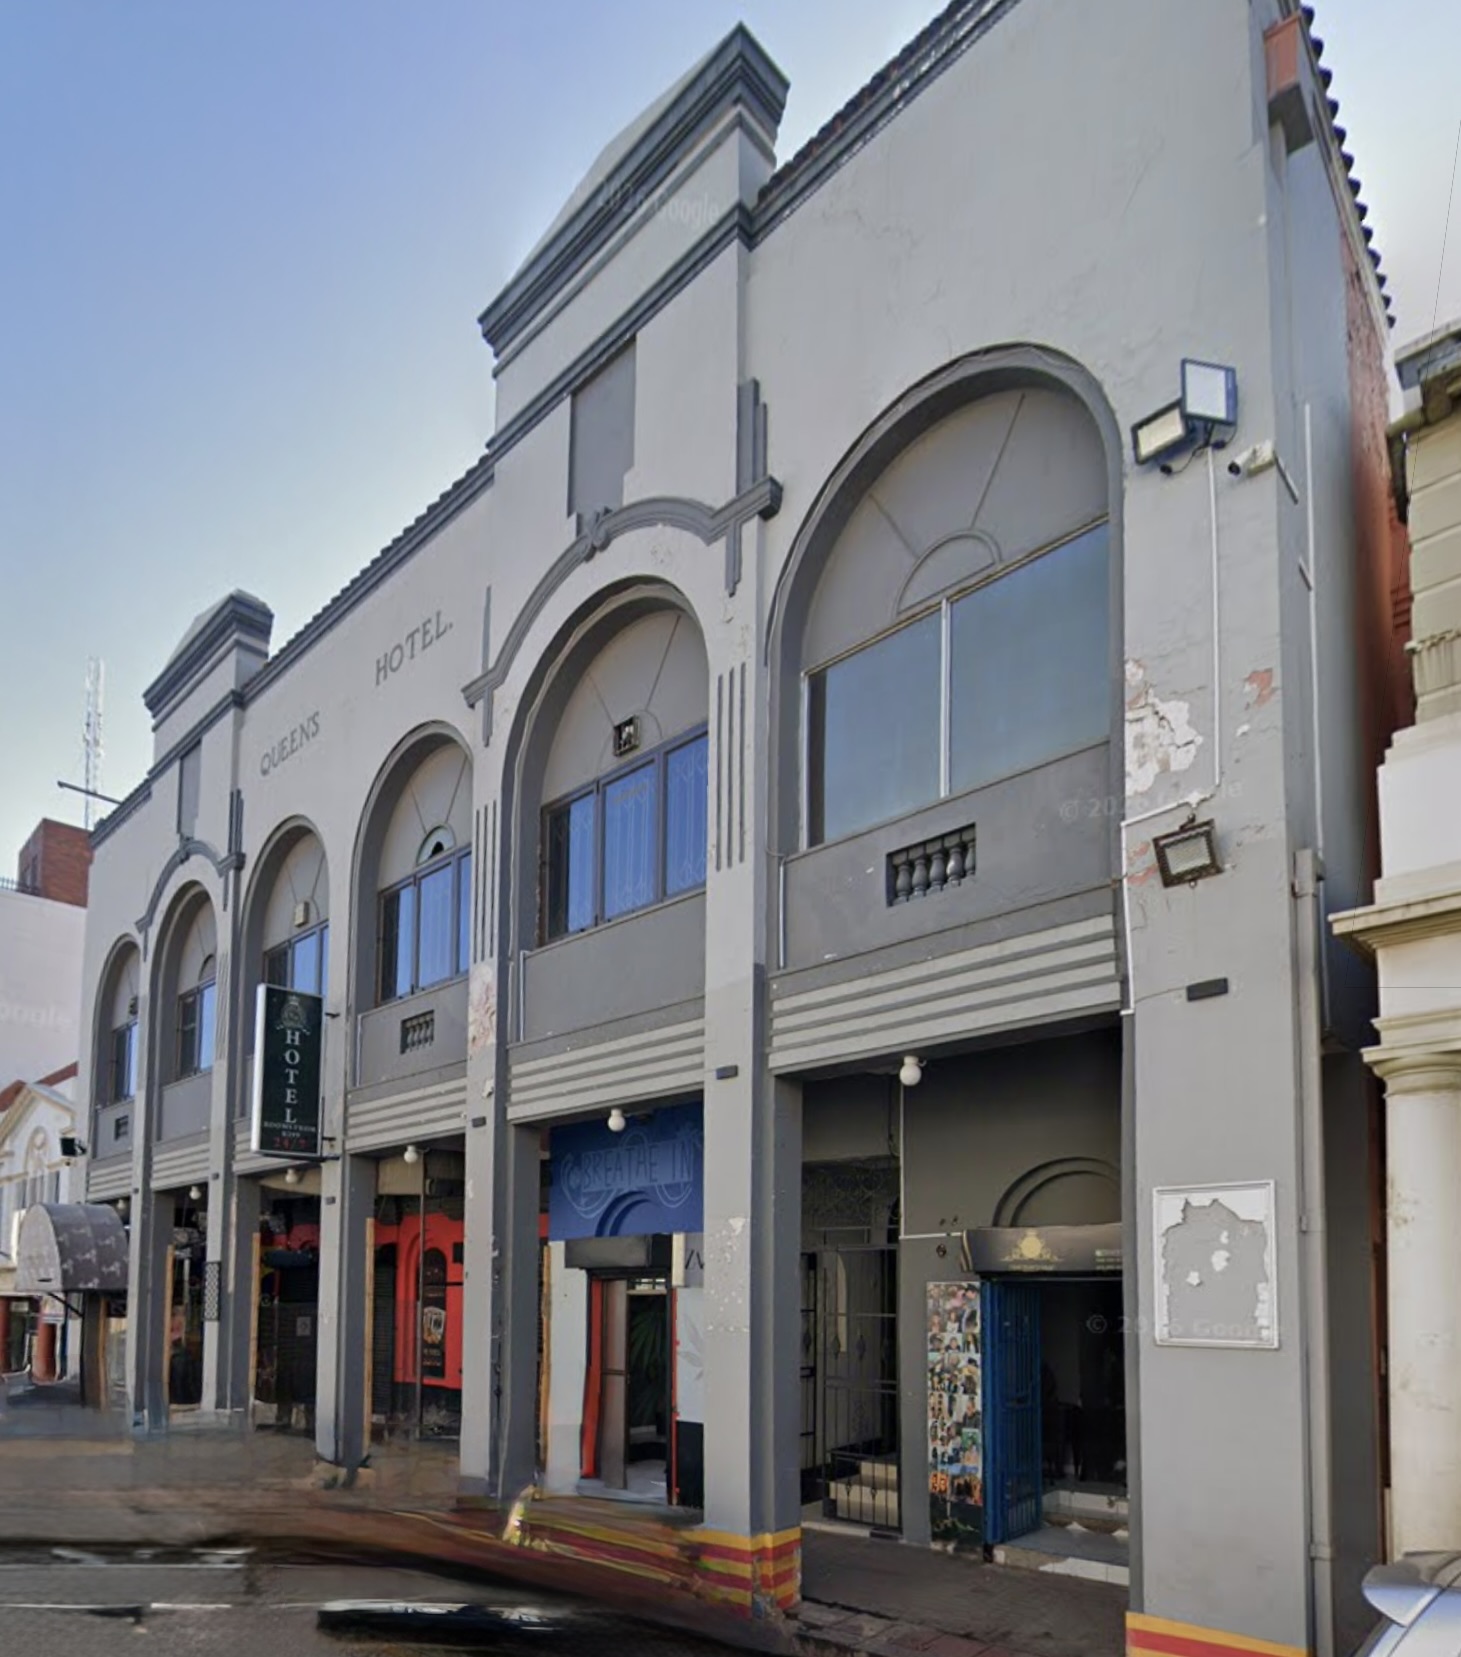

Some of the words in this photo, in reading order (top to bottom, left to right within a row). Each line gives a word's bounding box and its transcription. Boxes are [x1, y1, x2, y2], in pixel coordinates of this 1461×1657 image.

[284, 1029, 300, 1123] HOTEL
[583, 1143, 659, 1188] BREATHE
[671, 1139, 692, 1182] IN
